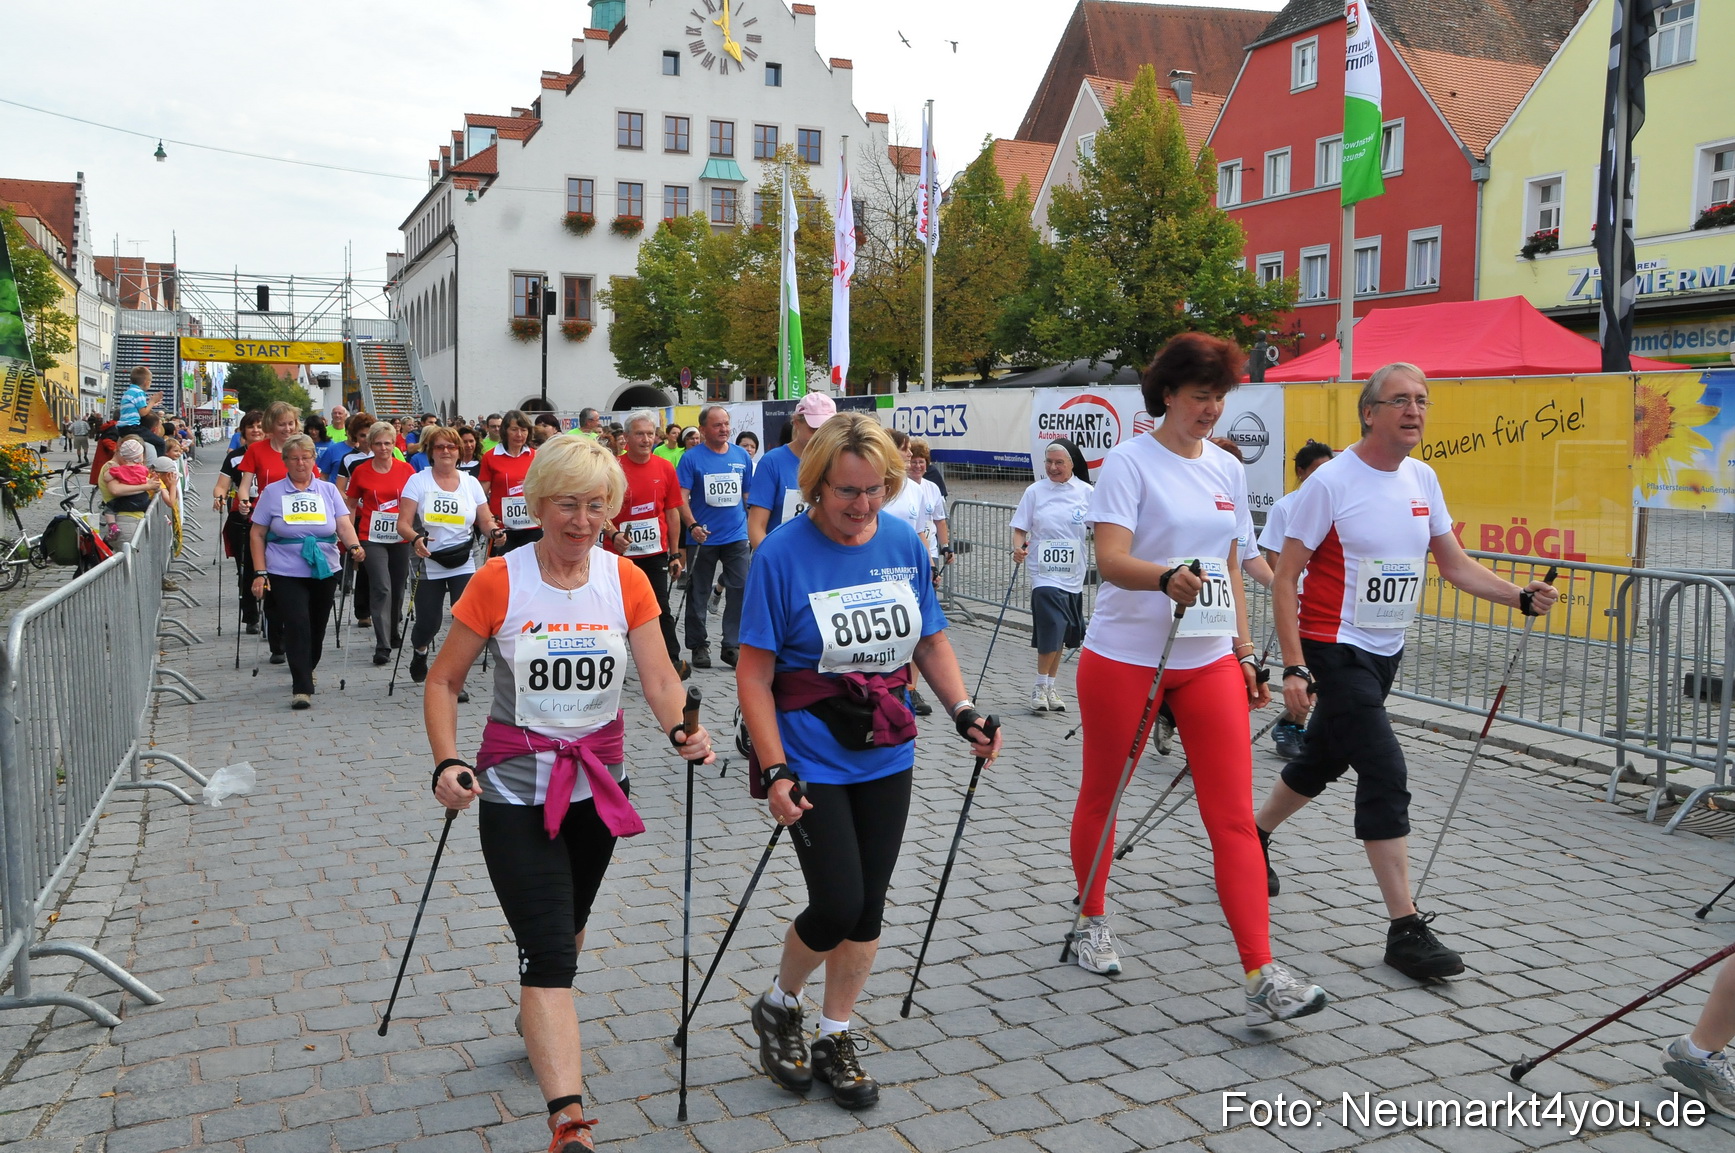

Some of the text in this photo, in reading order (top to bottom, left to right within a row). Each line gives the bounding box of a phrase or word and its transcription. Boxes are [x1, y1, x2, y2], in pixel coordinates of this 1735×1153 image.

[234, 343, 291, 357] START
[893, 404, 968, 437] BOCK
[1038, 413, 1111, 431] GERHART &
[1038, 431, 1068, 440] Autohaus
[1420, 397, 1585, 461] bauen für Sie!
[1230, 434, 1265, 443] NISSAN
[709, 481, 738, 496] 8029
[291, 500, 317, 513] 858
[433, 499, 458, 515] 859
[506, 505, 528, 518] 804
[374, 519, 397, 533] 801
[1480, 517, 1587, 563] BÖGL
[1043, 549, 1075, 564] 8031
[1381, 563, 1411, 572] BOCK
[840, 588, 884, 604] BOCK
[1187, 579, 1231, 608] 076
[1366, 576, 1419, 604] 8077
[831, 604, 912, 647] 8050
[547, 637, 596, 650] BOCK
[851, 647, 896, 666] Margit
[528, 656, 615, 691] 8098
